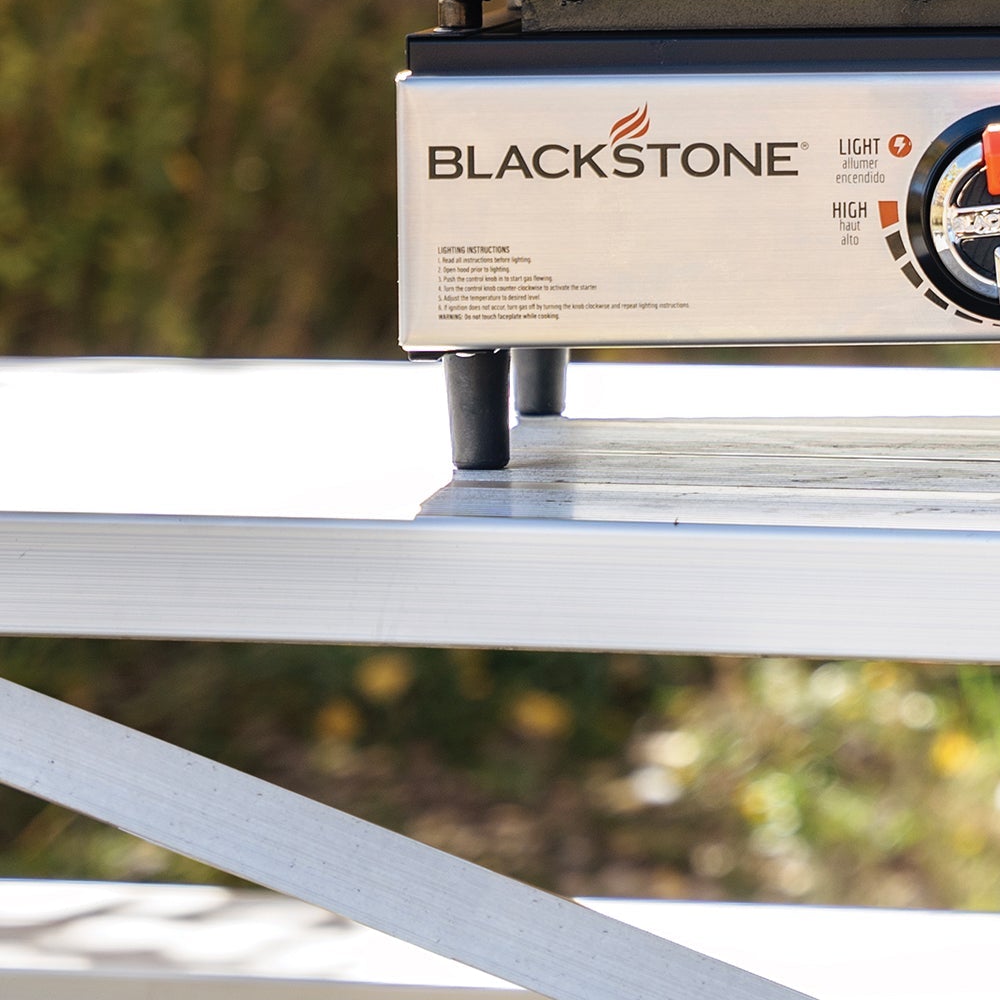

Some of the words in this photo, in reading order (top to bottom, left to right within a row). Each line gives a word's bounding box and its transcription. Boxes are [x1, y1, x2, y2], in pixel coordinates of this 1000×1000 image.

[840, 138, 880, 156] LIGHT
[842, 158, 878, 170] allumer
[835, 172, 886, 184] encendido
[832, 201, 868, 219] HIGH
[839, 219, 861, 232] haut
[841, 233, 860, 246] alto
[438, 247, 465, 255] LIGHTING
[467, 246, 510, 254] INSTRUCTIONS
